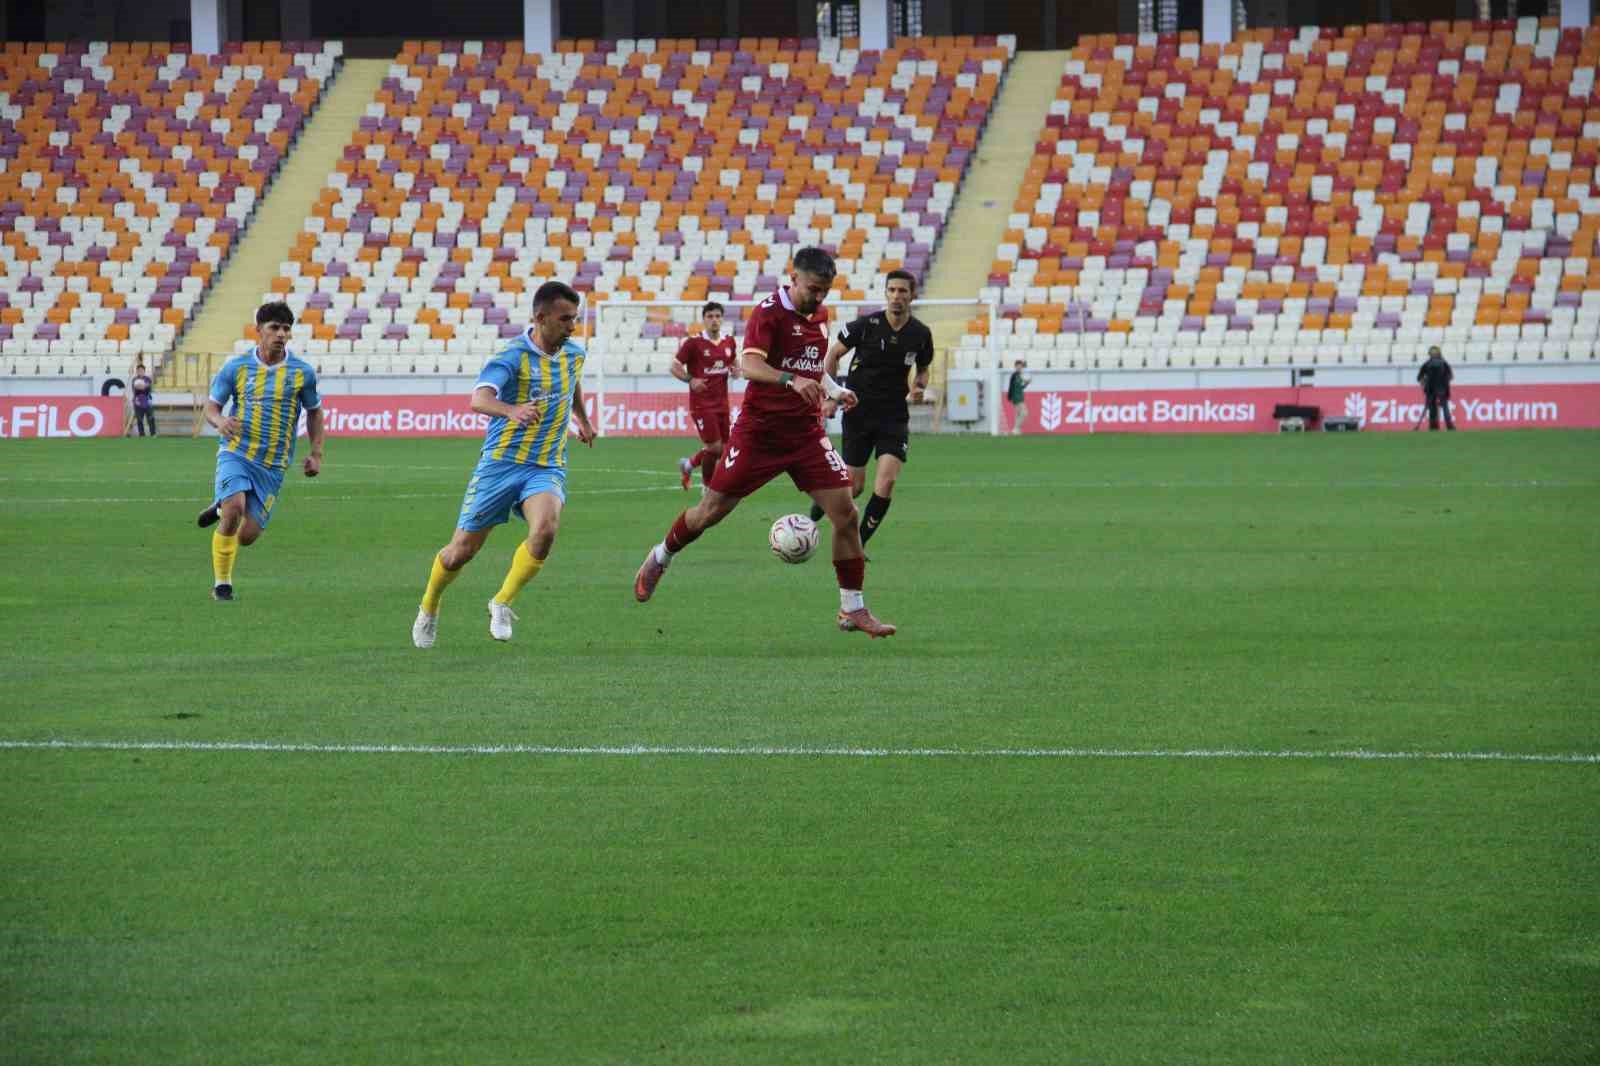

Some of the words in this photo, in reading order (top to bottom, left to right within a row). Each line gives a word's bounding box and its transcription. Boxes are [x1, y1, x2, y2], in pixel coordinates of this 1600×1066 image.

[397, 409, 489, 431] Bankas
[600, 404, 689, 430] Ziraat
[1065, 400, 1148, 423] Ziraat
[1152, 400, 1255, 422] Bankası
[1460, 399, 1557, 421] Yatırım
